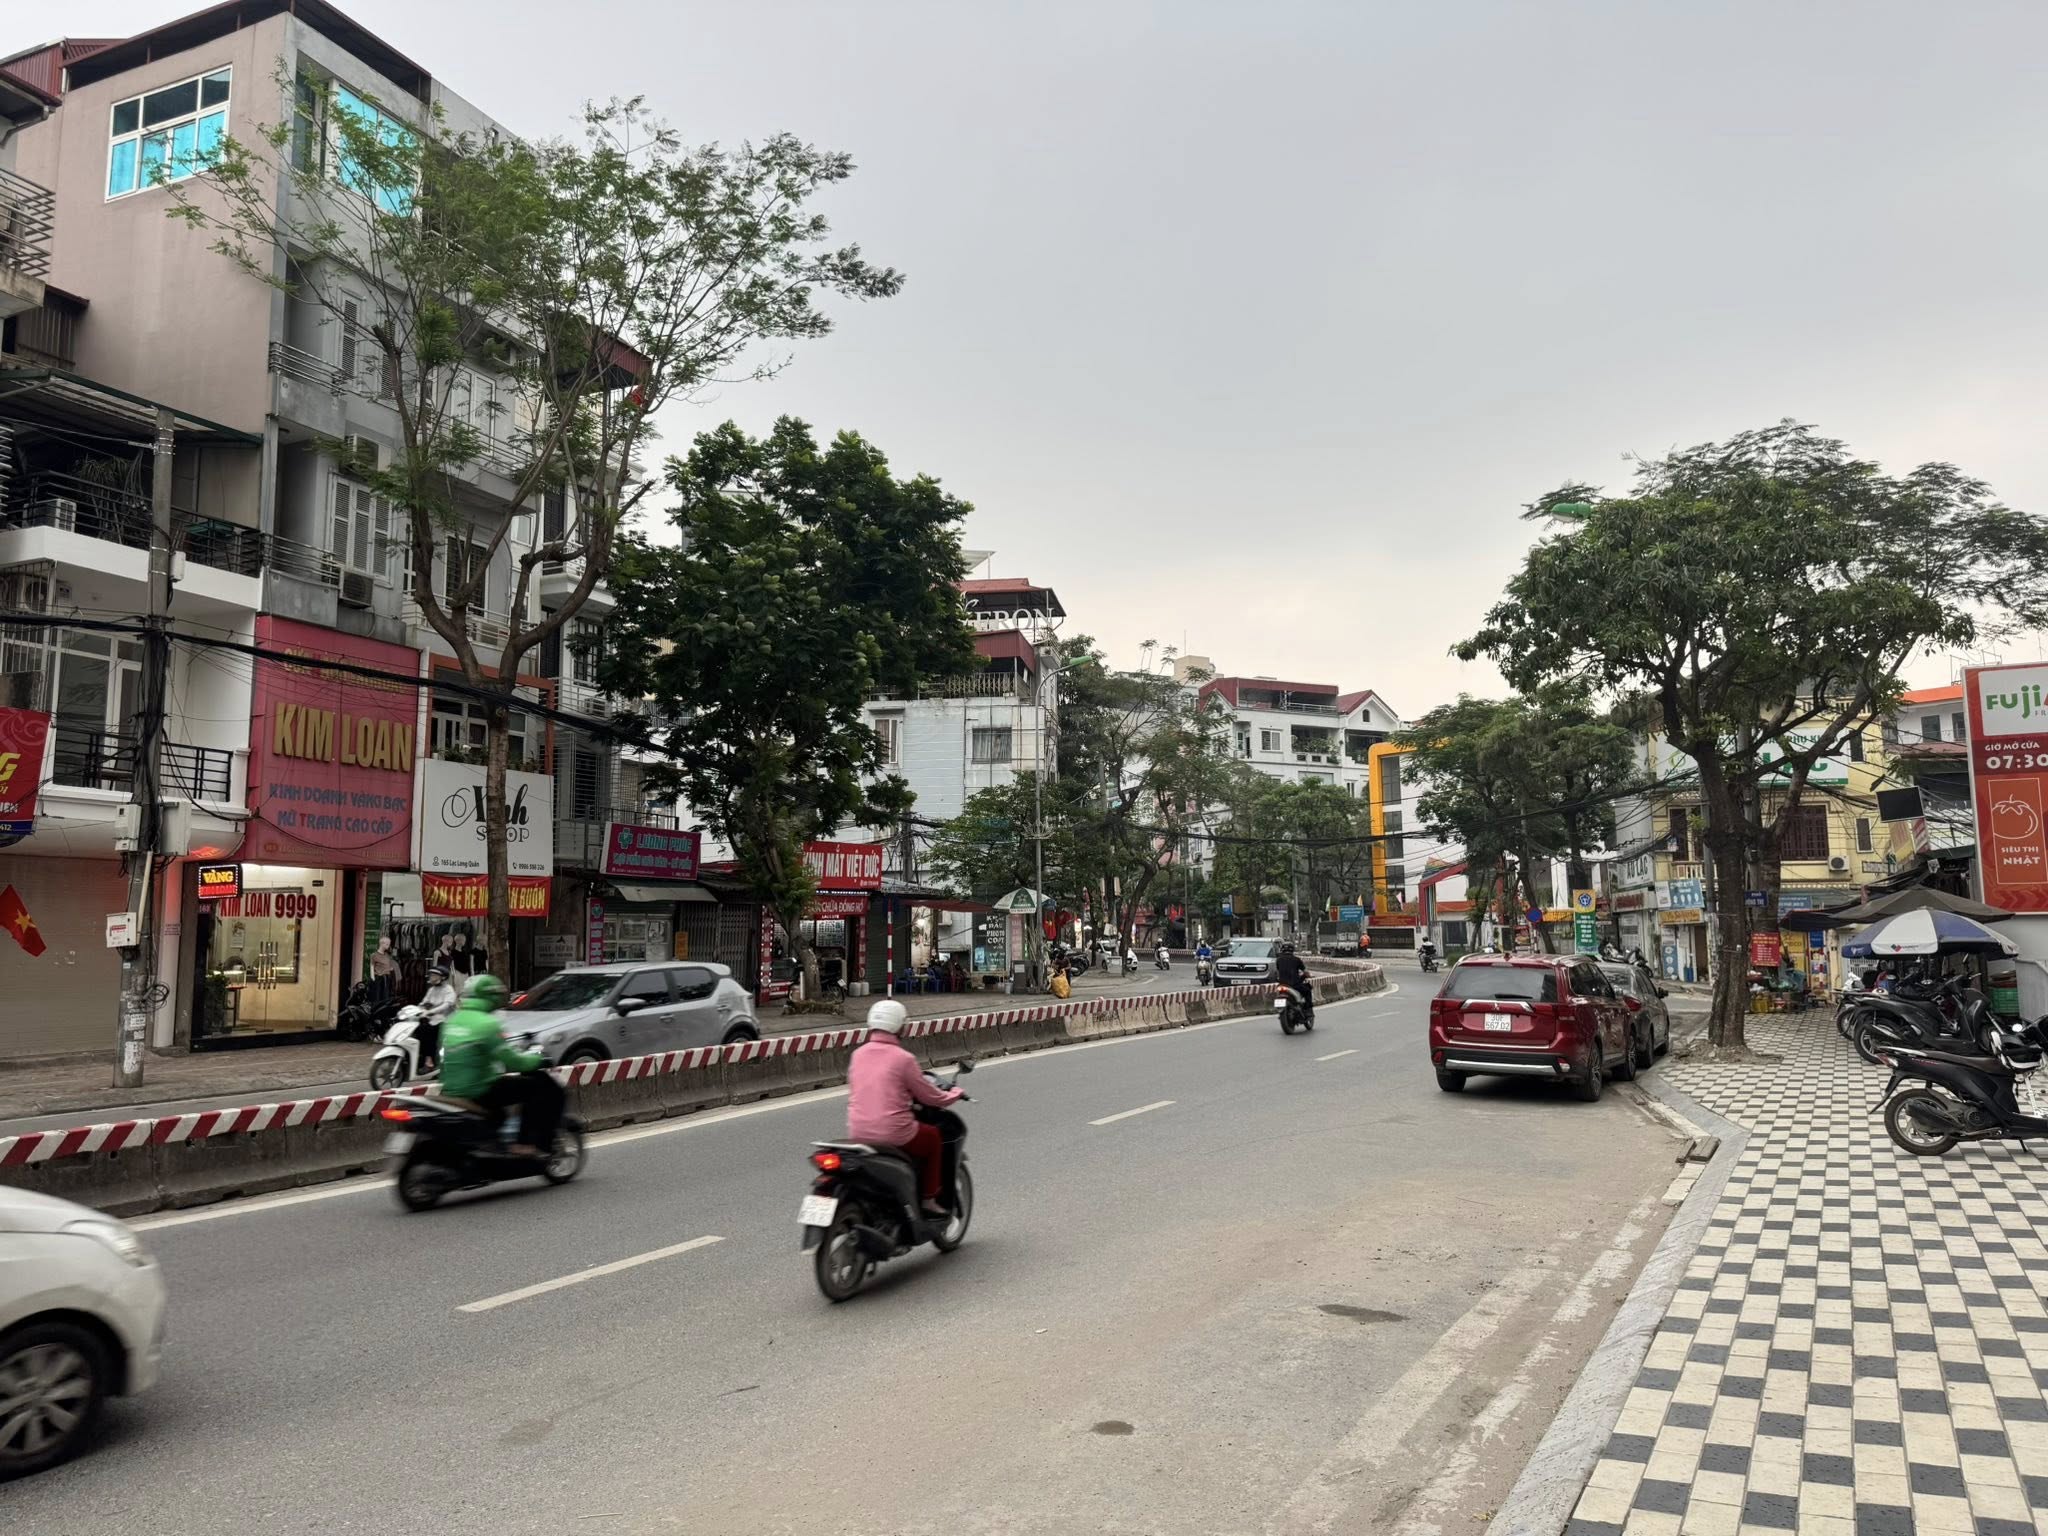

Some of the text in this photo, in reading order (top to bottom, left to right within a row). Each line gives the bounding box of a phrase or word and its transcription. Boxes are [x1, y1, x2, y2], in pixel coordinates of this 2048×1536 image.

[273, 703, 412, 772] KIM LOAN
[269, 783, 301, 800] KINH
[303, 786, 347, 805] DOANH
[345, 816, 370, 833] CAO
[475, 825, 531, 842] SOP
[846, 849, 863, 883] VIỆT
[2003, 856, 2041, 867] NHẬT
[203, 869, 234, 884] VÀNG
[245, 892, 271, 917] LOAN
[275, 894, 317, 918] 9999
